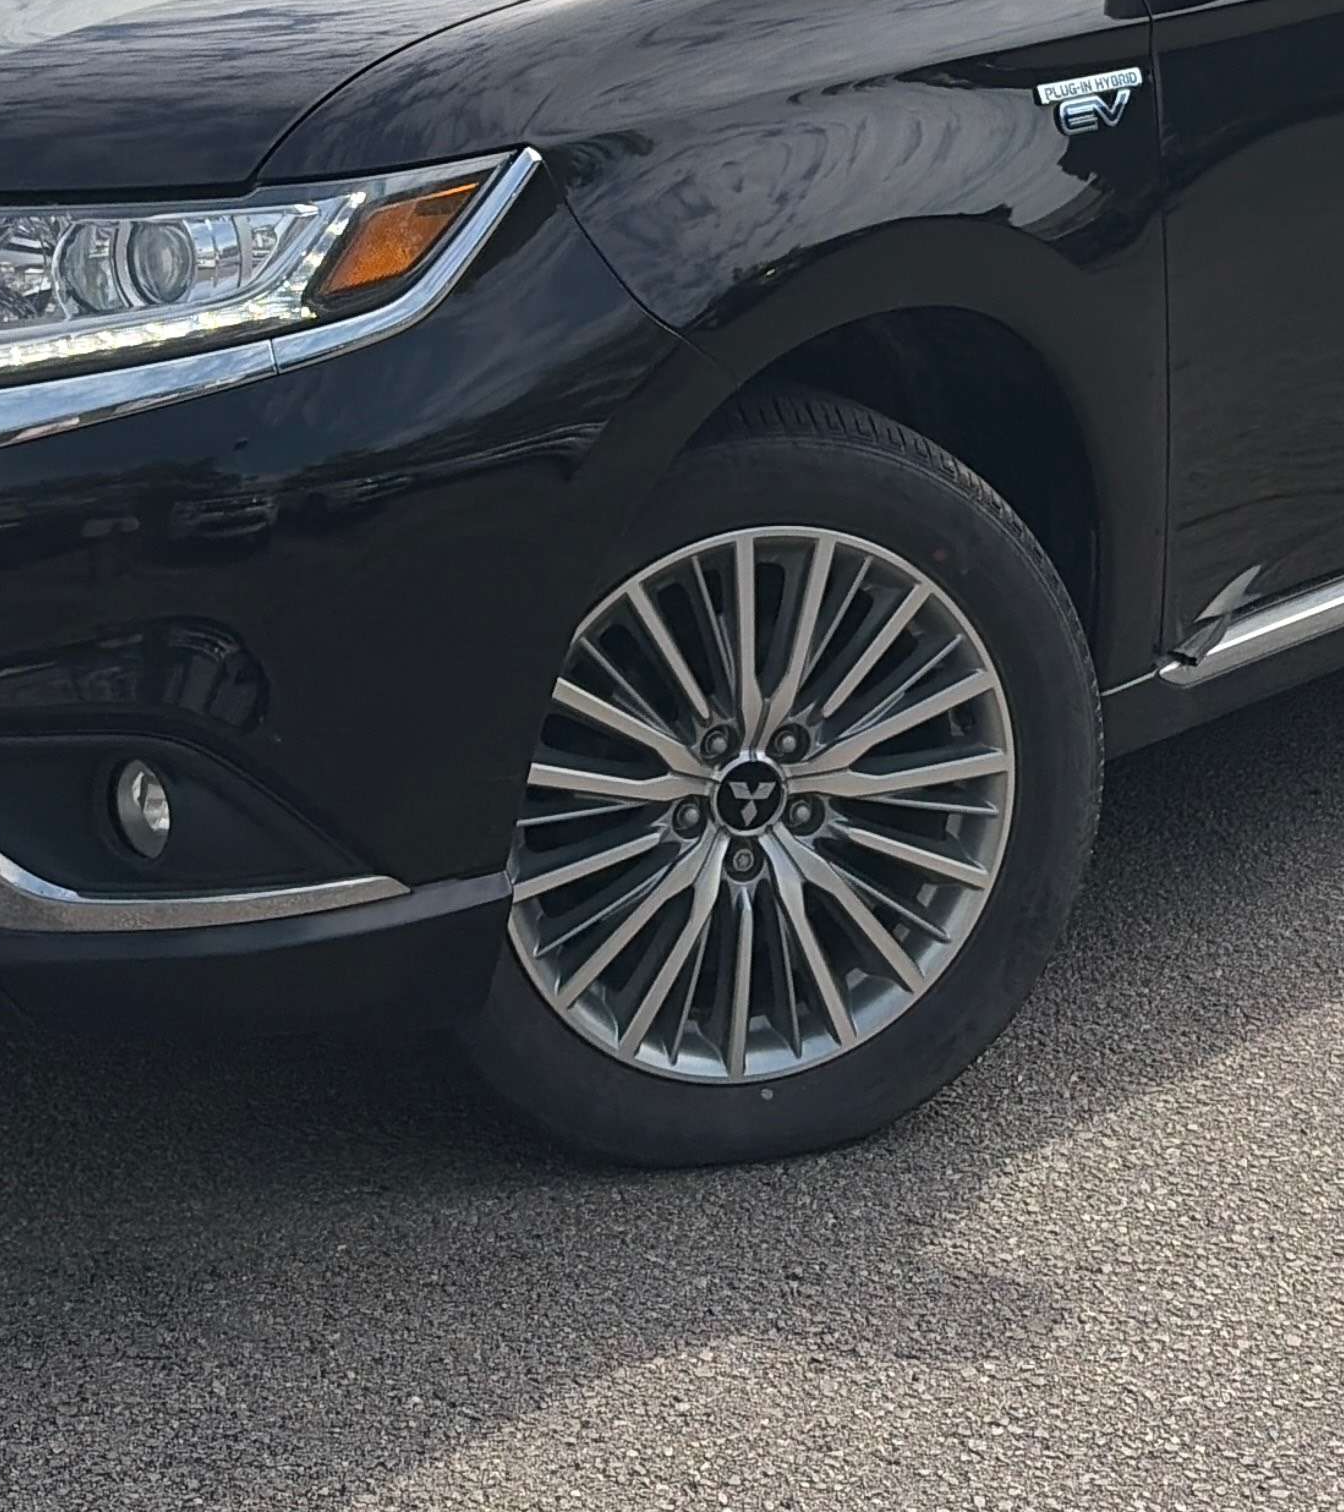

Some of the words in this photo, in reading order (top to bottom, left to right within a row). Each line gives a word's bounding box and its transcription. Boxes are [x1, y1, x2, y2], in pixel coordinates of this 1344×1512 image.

[1044, 81, 1092, 100] PLUG-IN
[1094, 72, 1138, 89] HYBRID
[1059, 89, 1131, 135] EV
